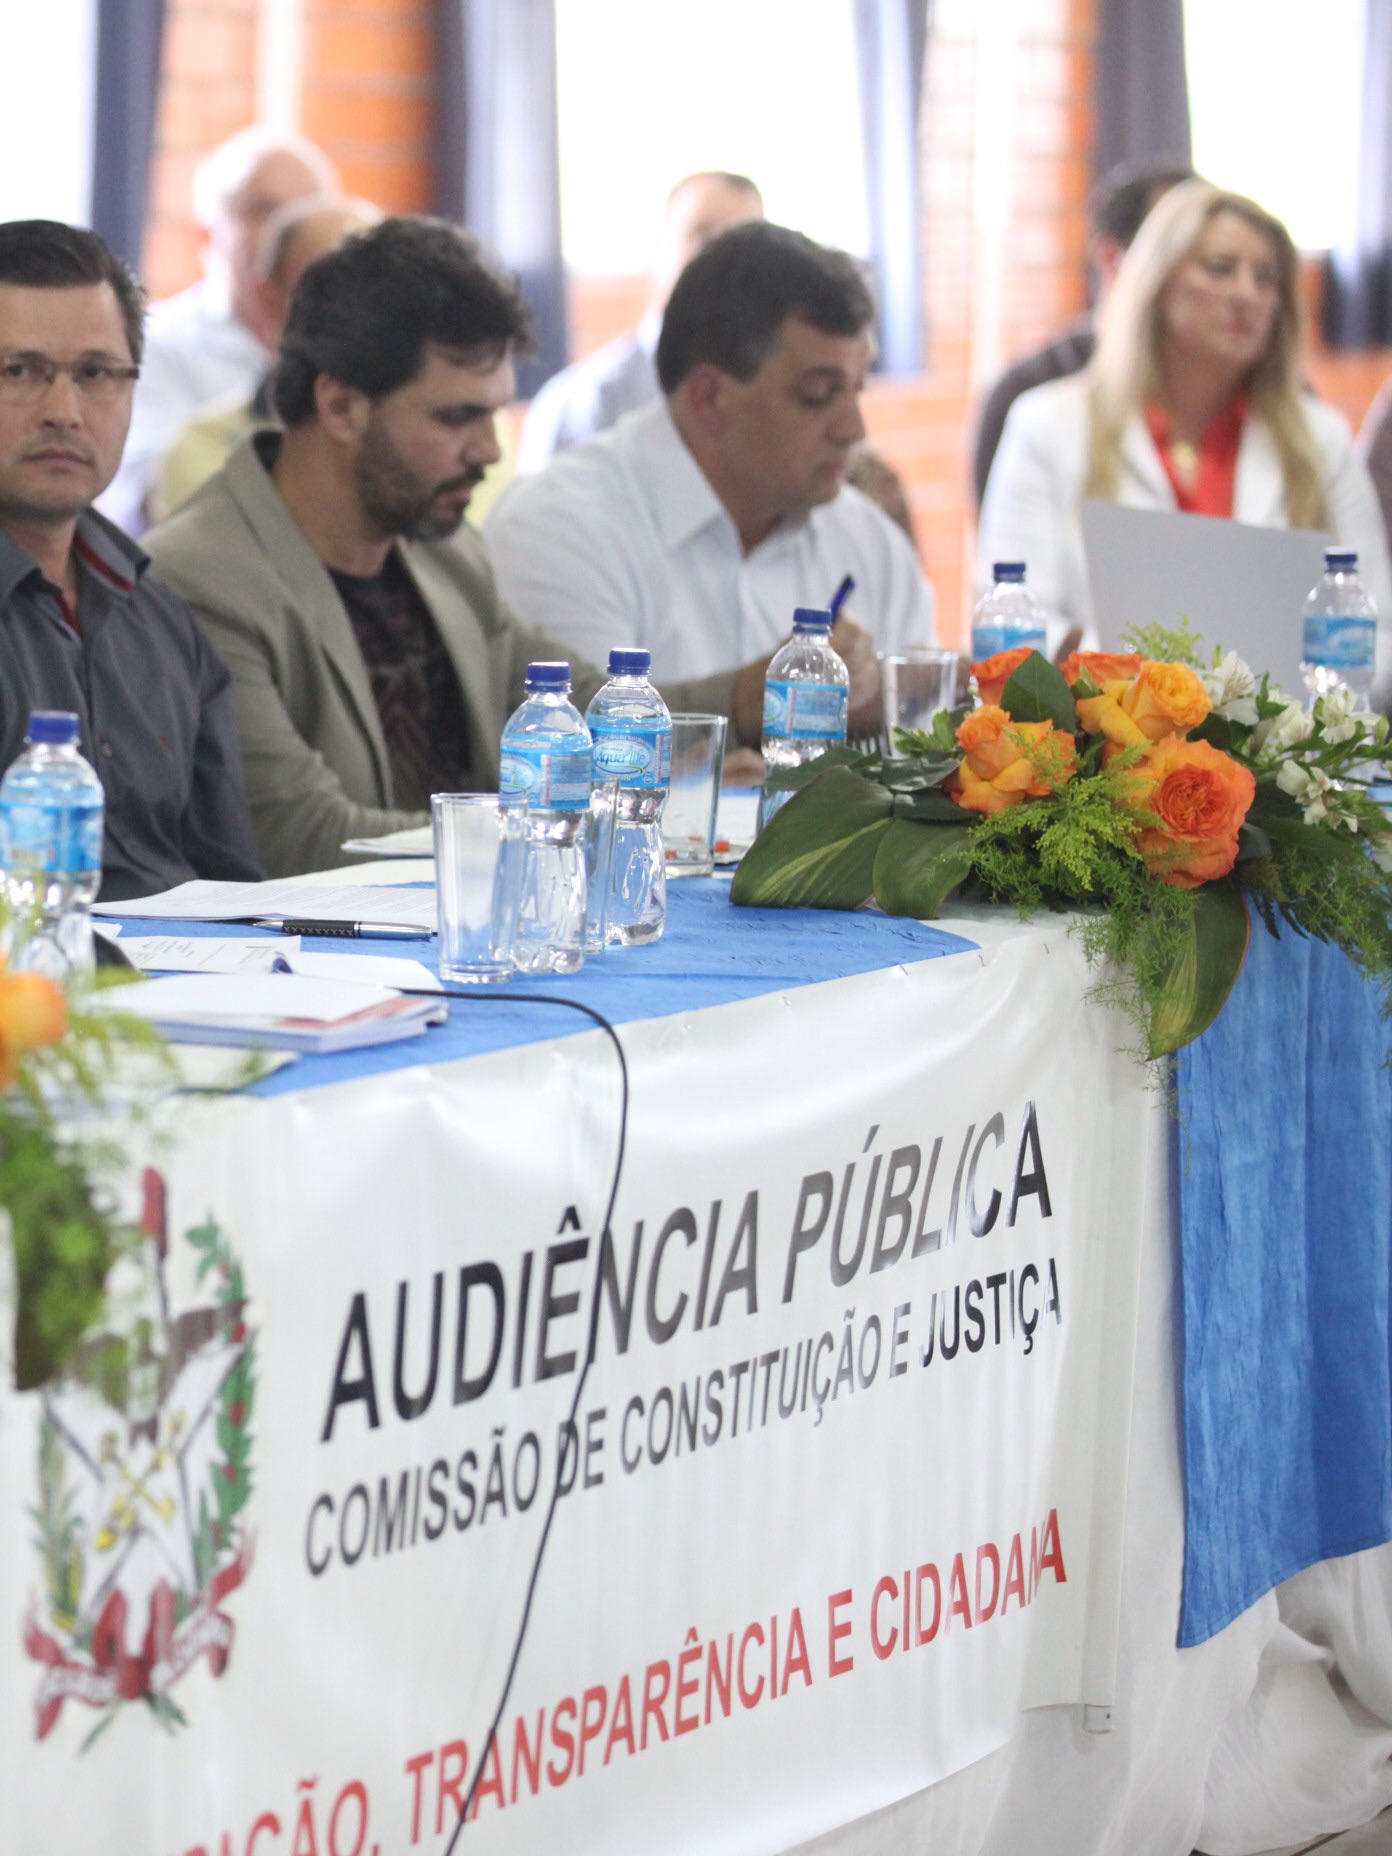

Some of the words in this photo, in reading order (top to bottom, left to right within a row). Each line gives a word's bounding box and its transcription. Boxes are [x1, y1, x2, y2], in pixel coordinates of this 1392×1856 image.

[305, 1425, 541, 1578] COMISSÃO
[556, 1407, 607, 1499] DE
[620, 1306, 882, 1476] CONSTITUIÇÃO
[889, 1302, 912, 1379] E
[919, 1258, 1063, 1369] JUSTIÇA
[319, 1190, 759, 1445] AUDIÊNCIA
[781, 1100, 1053, 1305] PÚBLICA
[403, 1607, 813, 1845] TRANSPARÊNCIA
[827, 1588, 854, 1678] E
